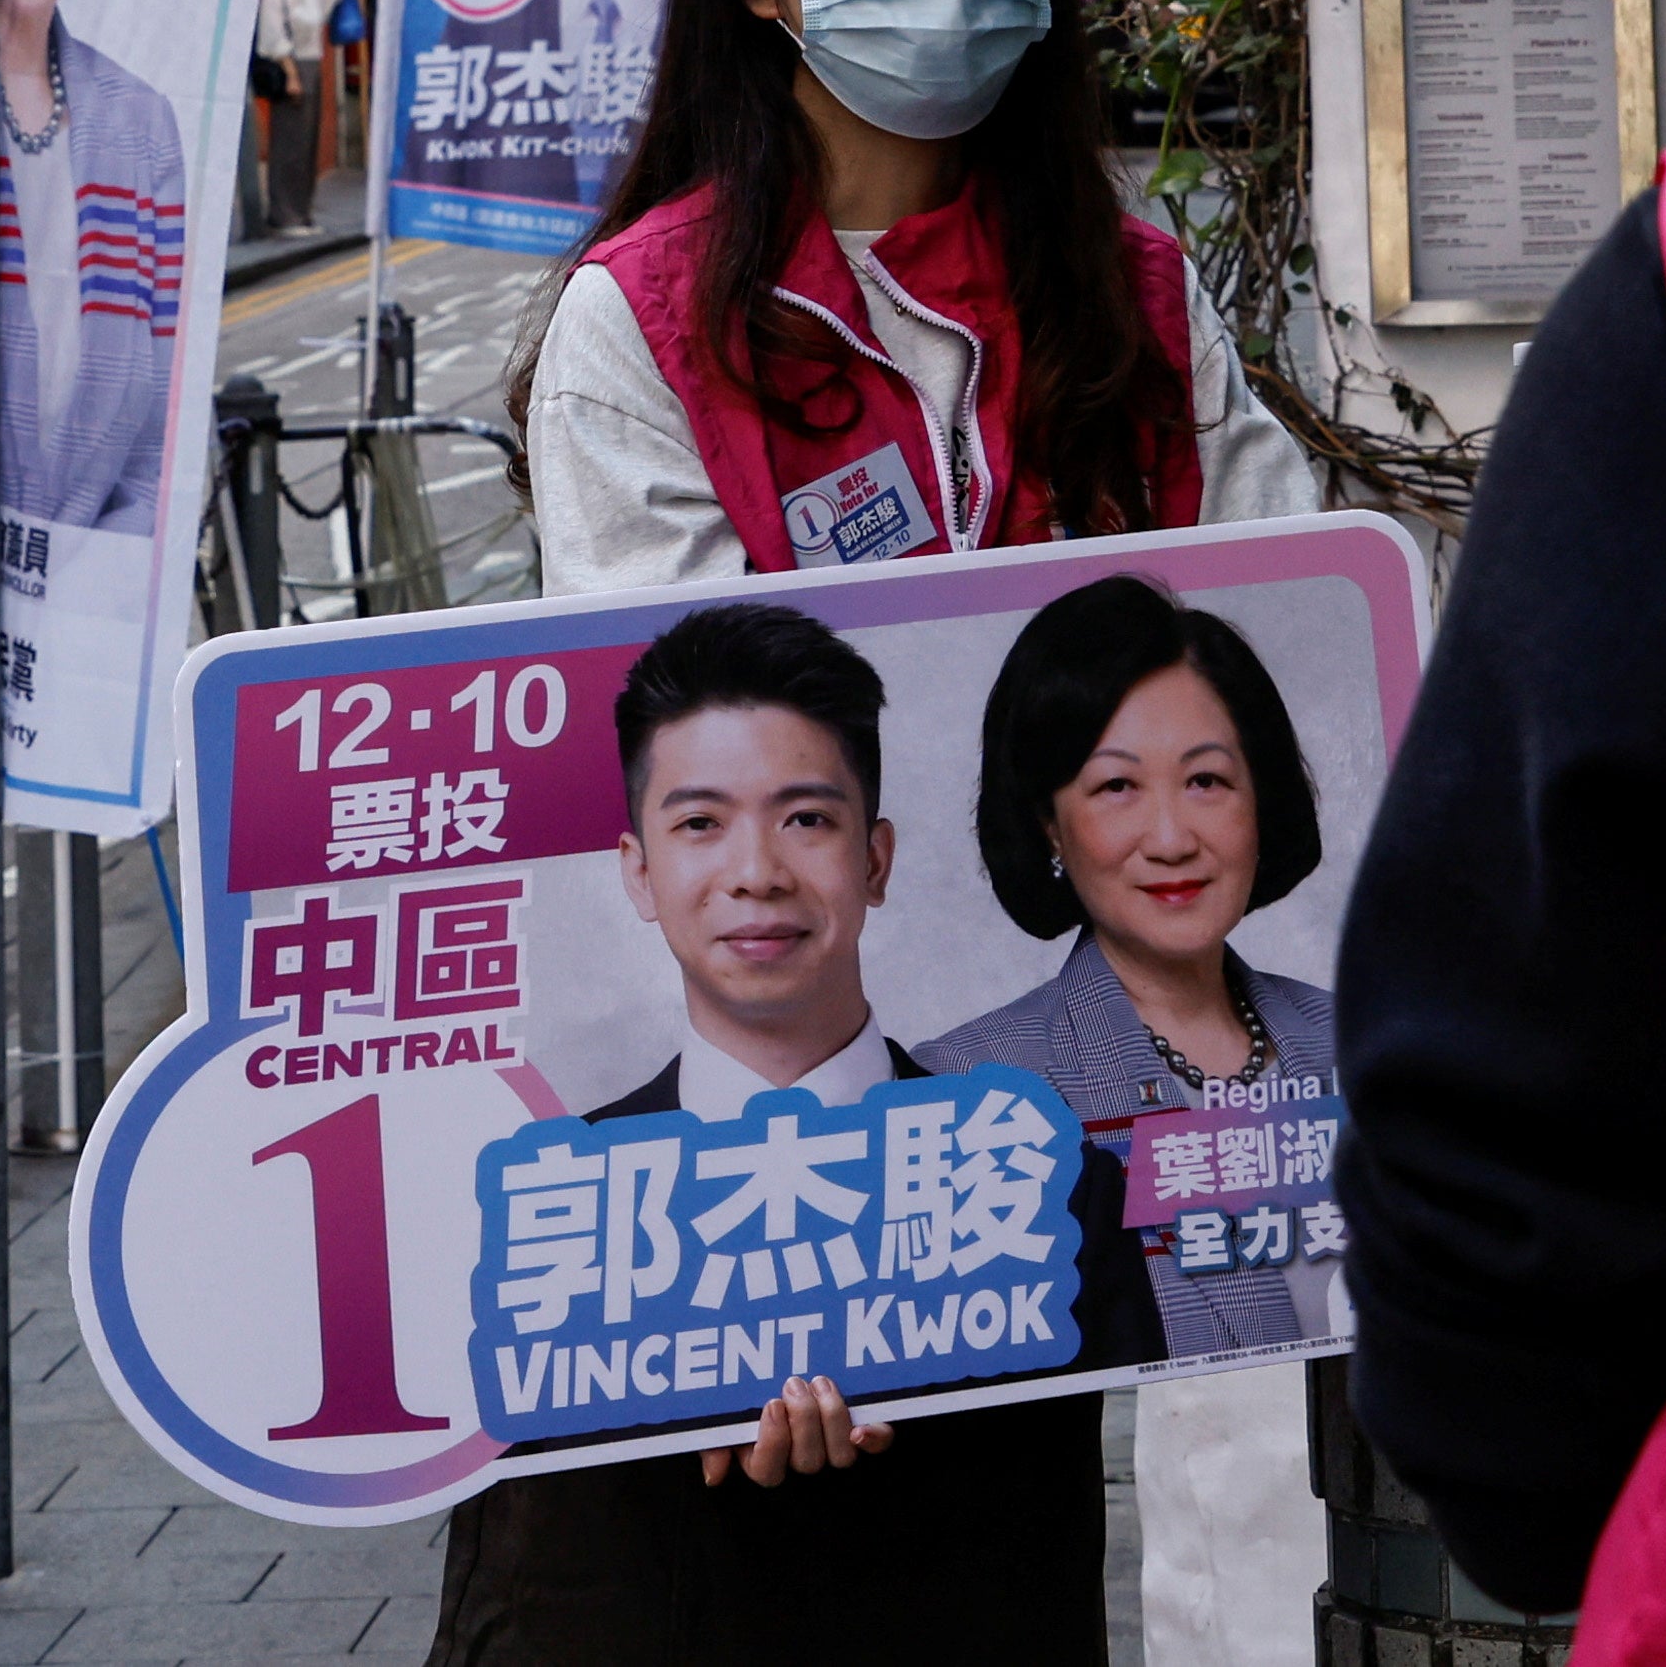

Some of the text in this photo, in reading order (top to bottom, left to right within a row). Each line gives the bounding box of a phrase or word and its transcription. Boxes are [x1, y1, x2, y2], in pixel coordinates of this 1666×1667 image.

[410, 39, 654, 132] 郭杰駿
[426, 139, 495, 162] KWOK
[797, 505, 824, 541] 1
[837, 496, 900, 550] 郭杰駿
[839, 481, 880, 514] Vote for
[325, 768, 510, 872] 票投
[249, 879, 525, 1038] 中區
[245, 1024, 515, 1089] CENTRAL
[1202, 1067, 1340, 1113] Regina I
[1152, 1119, 1338, 1202] 葉劉淑
[497, 1089, 1058, 1335] 郭杰駿
[1178, 1200, 1348, 1268] 全力支
[250, 1093, 451, 1442] 1
[495, 1281, 1056, 1415] VINCENT KWOK
